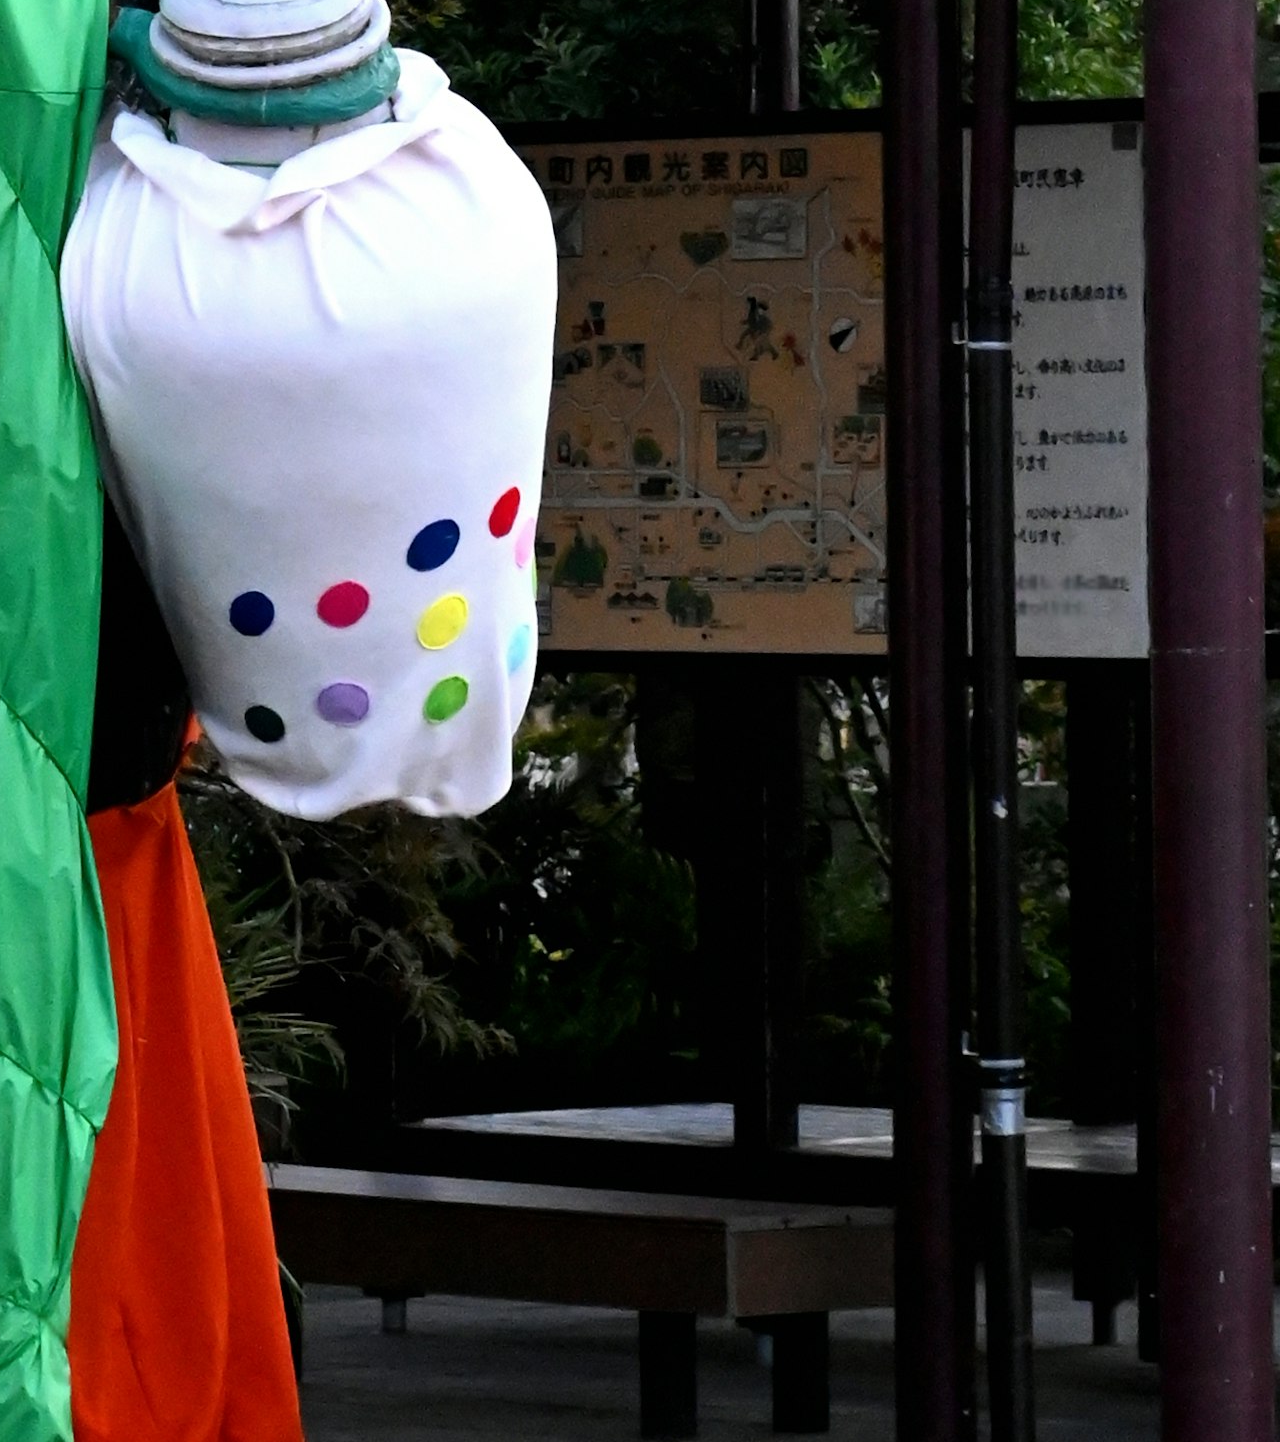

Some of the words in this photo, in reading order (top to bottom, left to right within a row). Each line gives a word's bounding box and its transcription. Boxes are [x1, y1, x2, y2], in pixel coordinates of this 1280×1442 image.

[523, 148, 808, 184] 町内観光案内図
[682, 183, 703, 196] OF
